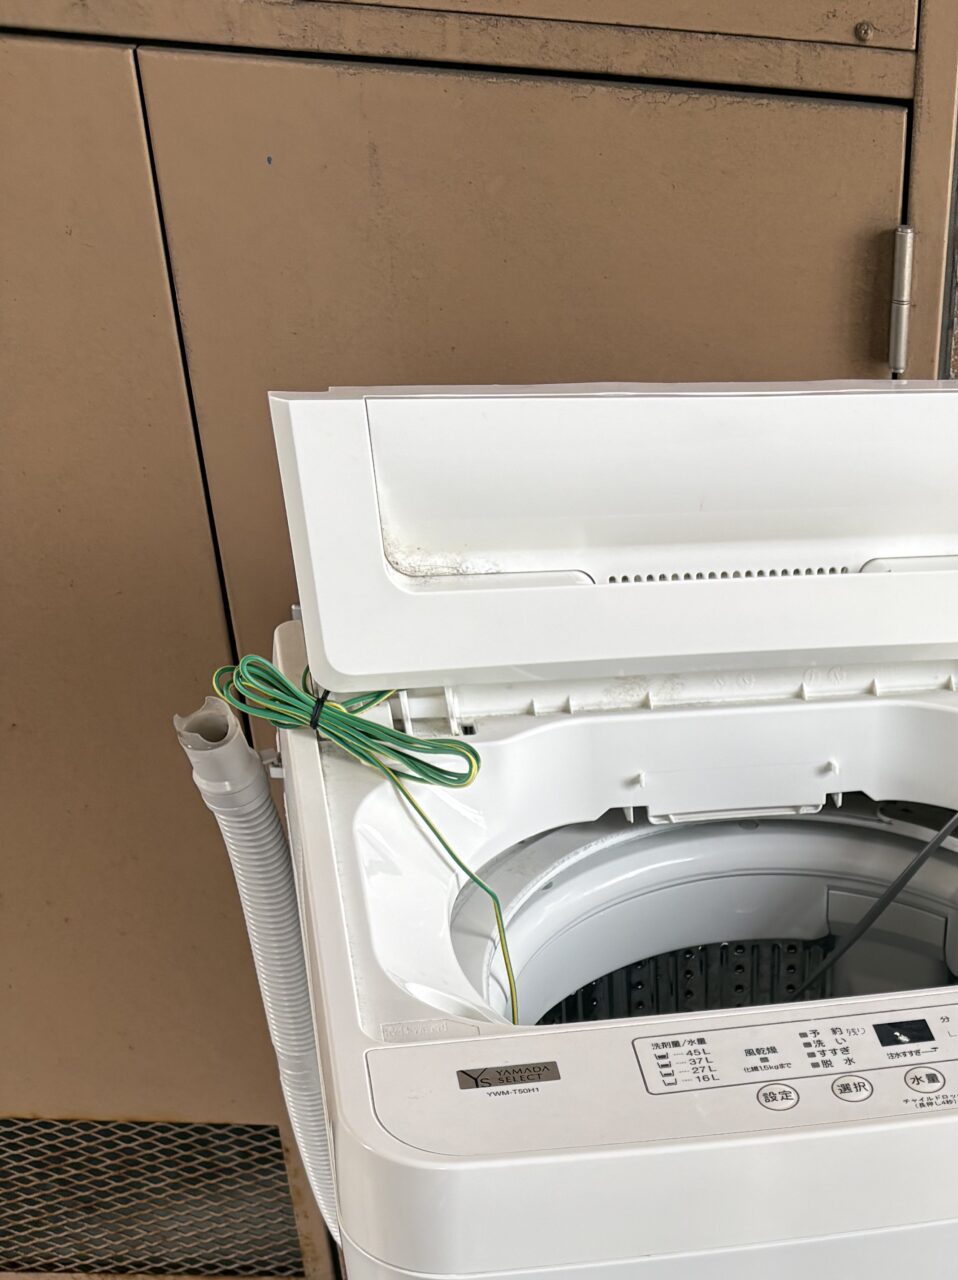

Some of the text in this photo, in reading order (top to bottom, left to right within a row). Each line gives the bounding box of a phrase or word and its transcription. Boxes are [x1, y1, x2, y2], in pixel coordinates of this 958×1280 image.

[744, 1046, 778, 1056] 風乾燥
[817, 1046, 850, 1057] すすぎ
[496, 1065, 551, 1076] YAMADA
[498, 1073, 544, 1083] SELECT
[910, 1073, 940, 1085] 水量
[486, 1087, 540, 1097] YWM-T50H1
[837, 1081, 868, 1094] 選択
[763, 1090, 794, 1102] 設定
